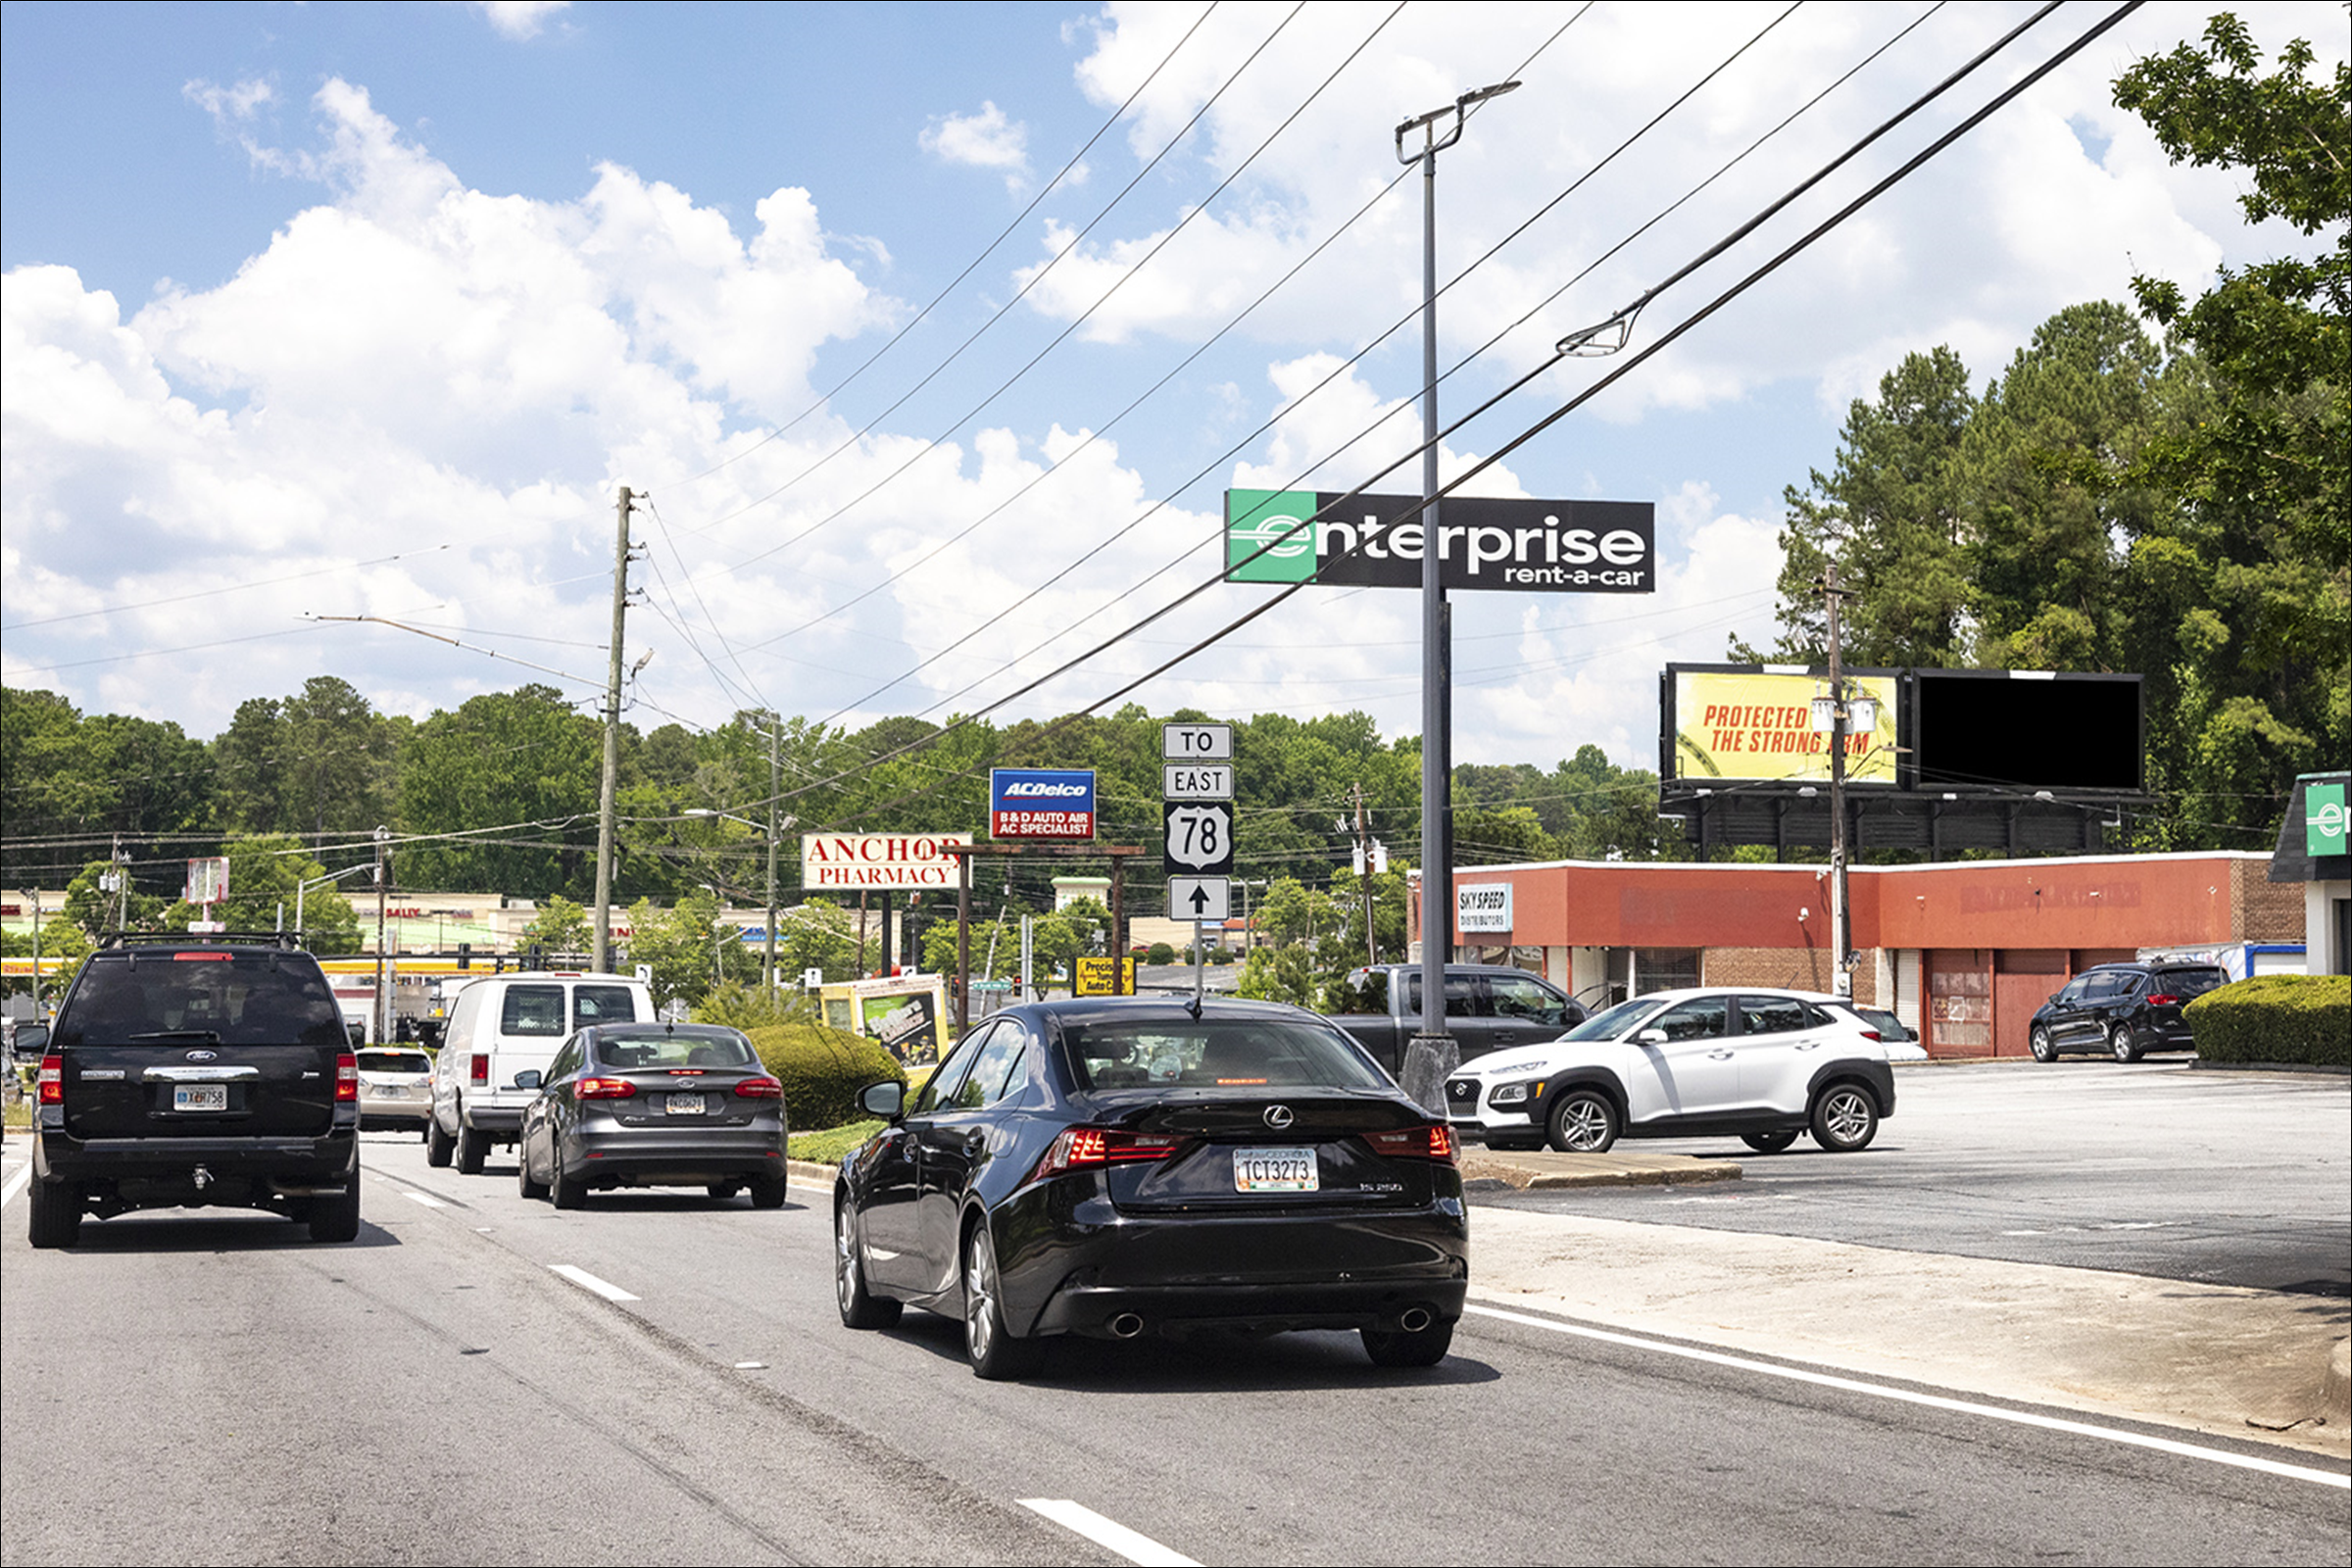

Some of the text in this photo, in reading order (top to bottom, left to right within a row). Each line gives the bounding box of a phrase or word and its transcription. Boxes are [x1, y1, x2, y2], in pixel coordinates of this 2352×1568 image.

[1231, 514, 1646, 575] enterprise
[1504, 564, 1644, 586] rent-a-car
[1703, 705, 1808, 729] PROTECTED
[1180, 732, 1213, 752] TO
[1711, 729, 1870, 755] THE STRONG RM
[1004, 782, 1088, 797] ACDelco
[1175, 771, 1222, 791] EAST
[1000, 811, 1008, 823] B
[1021, 812, 1030, 823] D
[1032, 812, 1066, 823] AUTO
[1067, 812, 1088, 824] AIR
[999, 823, 1089, 835] AC SPECIALIST
[1180, 816, 1217, 856] 78
[819, 867, 951, 884] PHARMACY
[386, 907, 420, 918] SALLY
[1243, 1160, 1310, 1181] TCT3273
